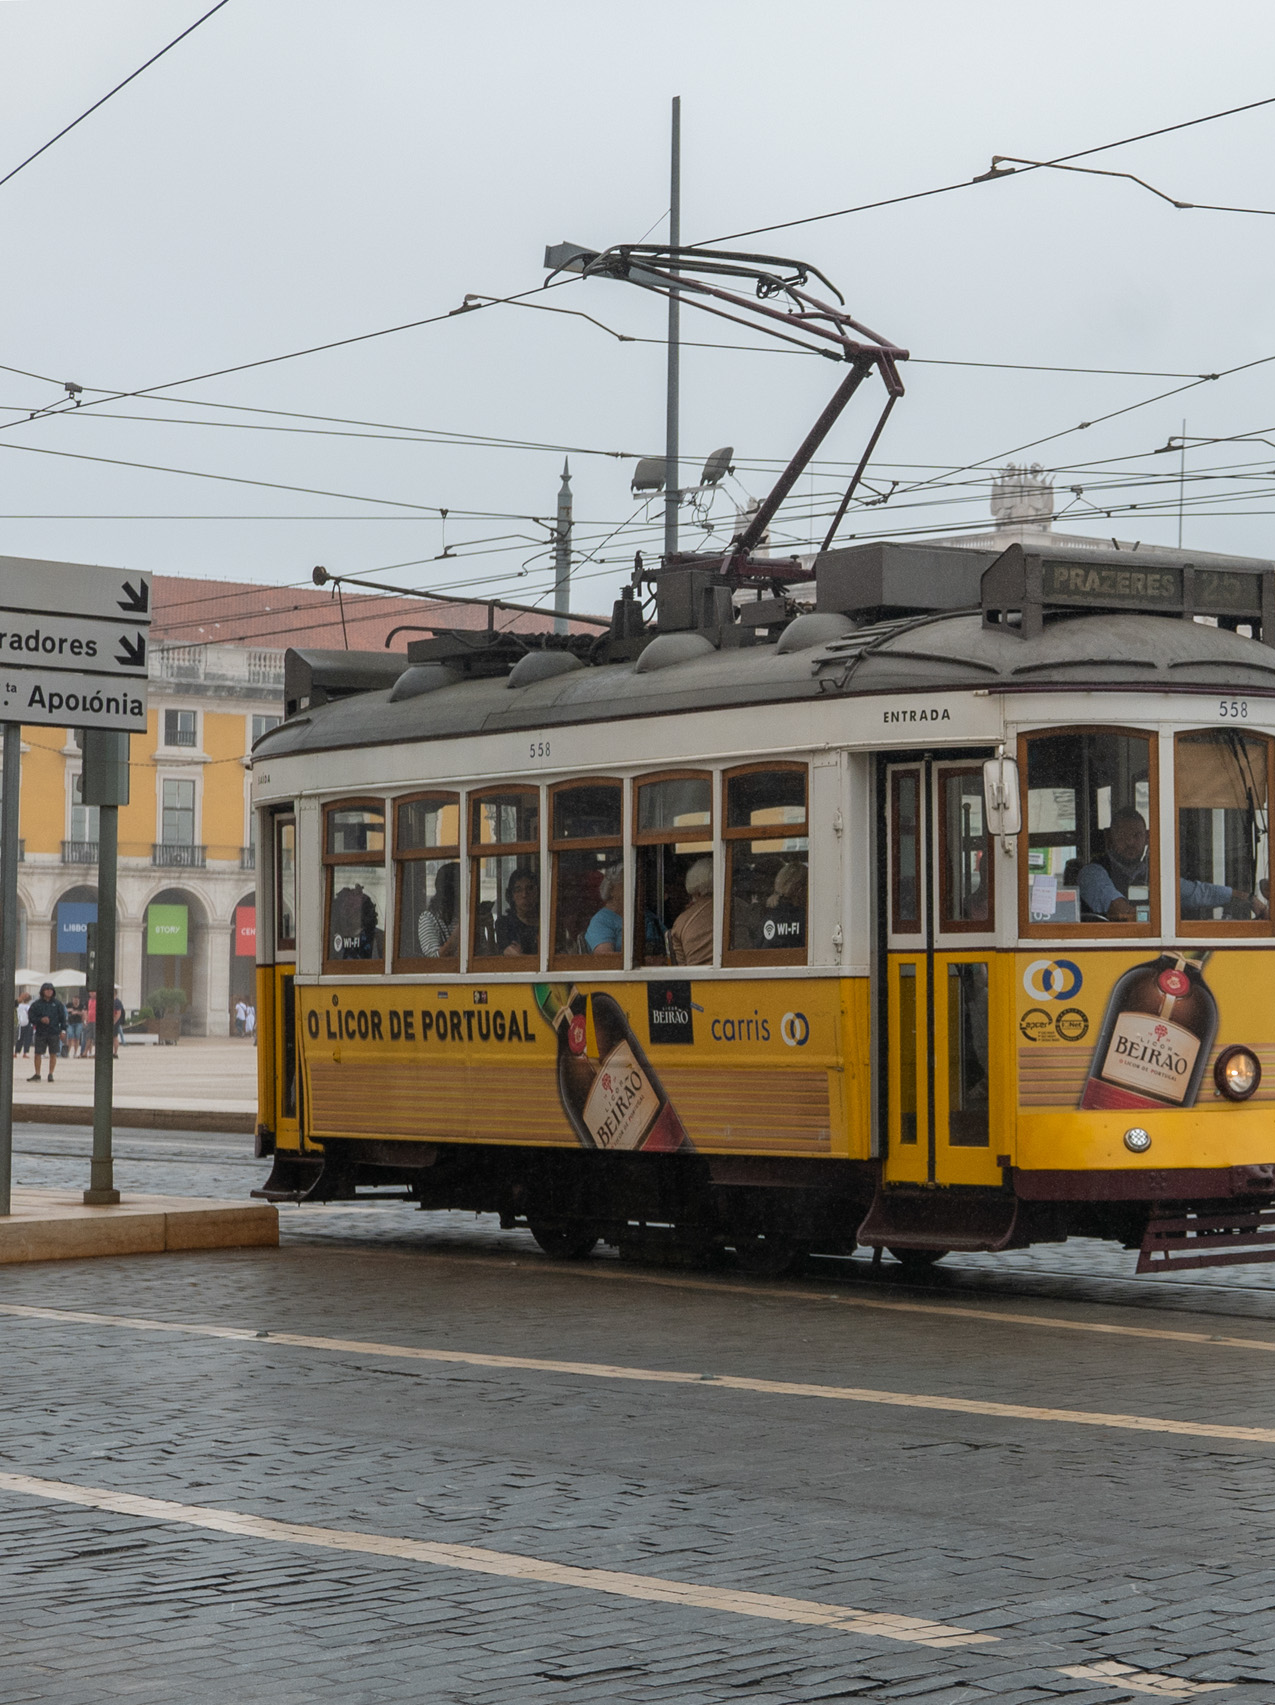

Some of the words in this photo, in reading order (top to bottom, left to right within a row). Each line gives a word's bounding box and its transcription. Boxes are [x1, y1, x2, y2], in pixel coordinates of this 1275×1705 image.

[1054, 567, 1175, 596] PRAZERES
[28, 685, 143, 717] Apolónia
[1219, 701, 1248, 718] 558
[883, 708, 951, 723] ENTRADA
[529, 741, 551, 758] 558
[155, 925, 180, 934] STORY
[776, 922, 800, 936] WI-FI
[653, 1008, 689, 1025] BEIRÃO
[711, 1009, 771, 1041] carris
[307, 1009, 319, 1040] O
[326, 1009, 384, 1041] LICOR
[389, 1009, 416, 1042] DE
[421, 1009, 536, 1042] PORTUGAL
[1140, 1036, 1172, 1052] LICOR
[1114, 1035, 1188, 1075] BEIRÃO
[596, 1070, 642, 1148] BEIRÃO
